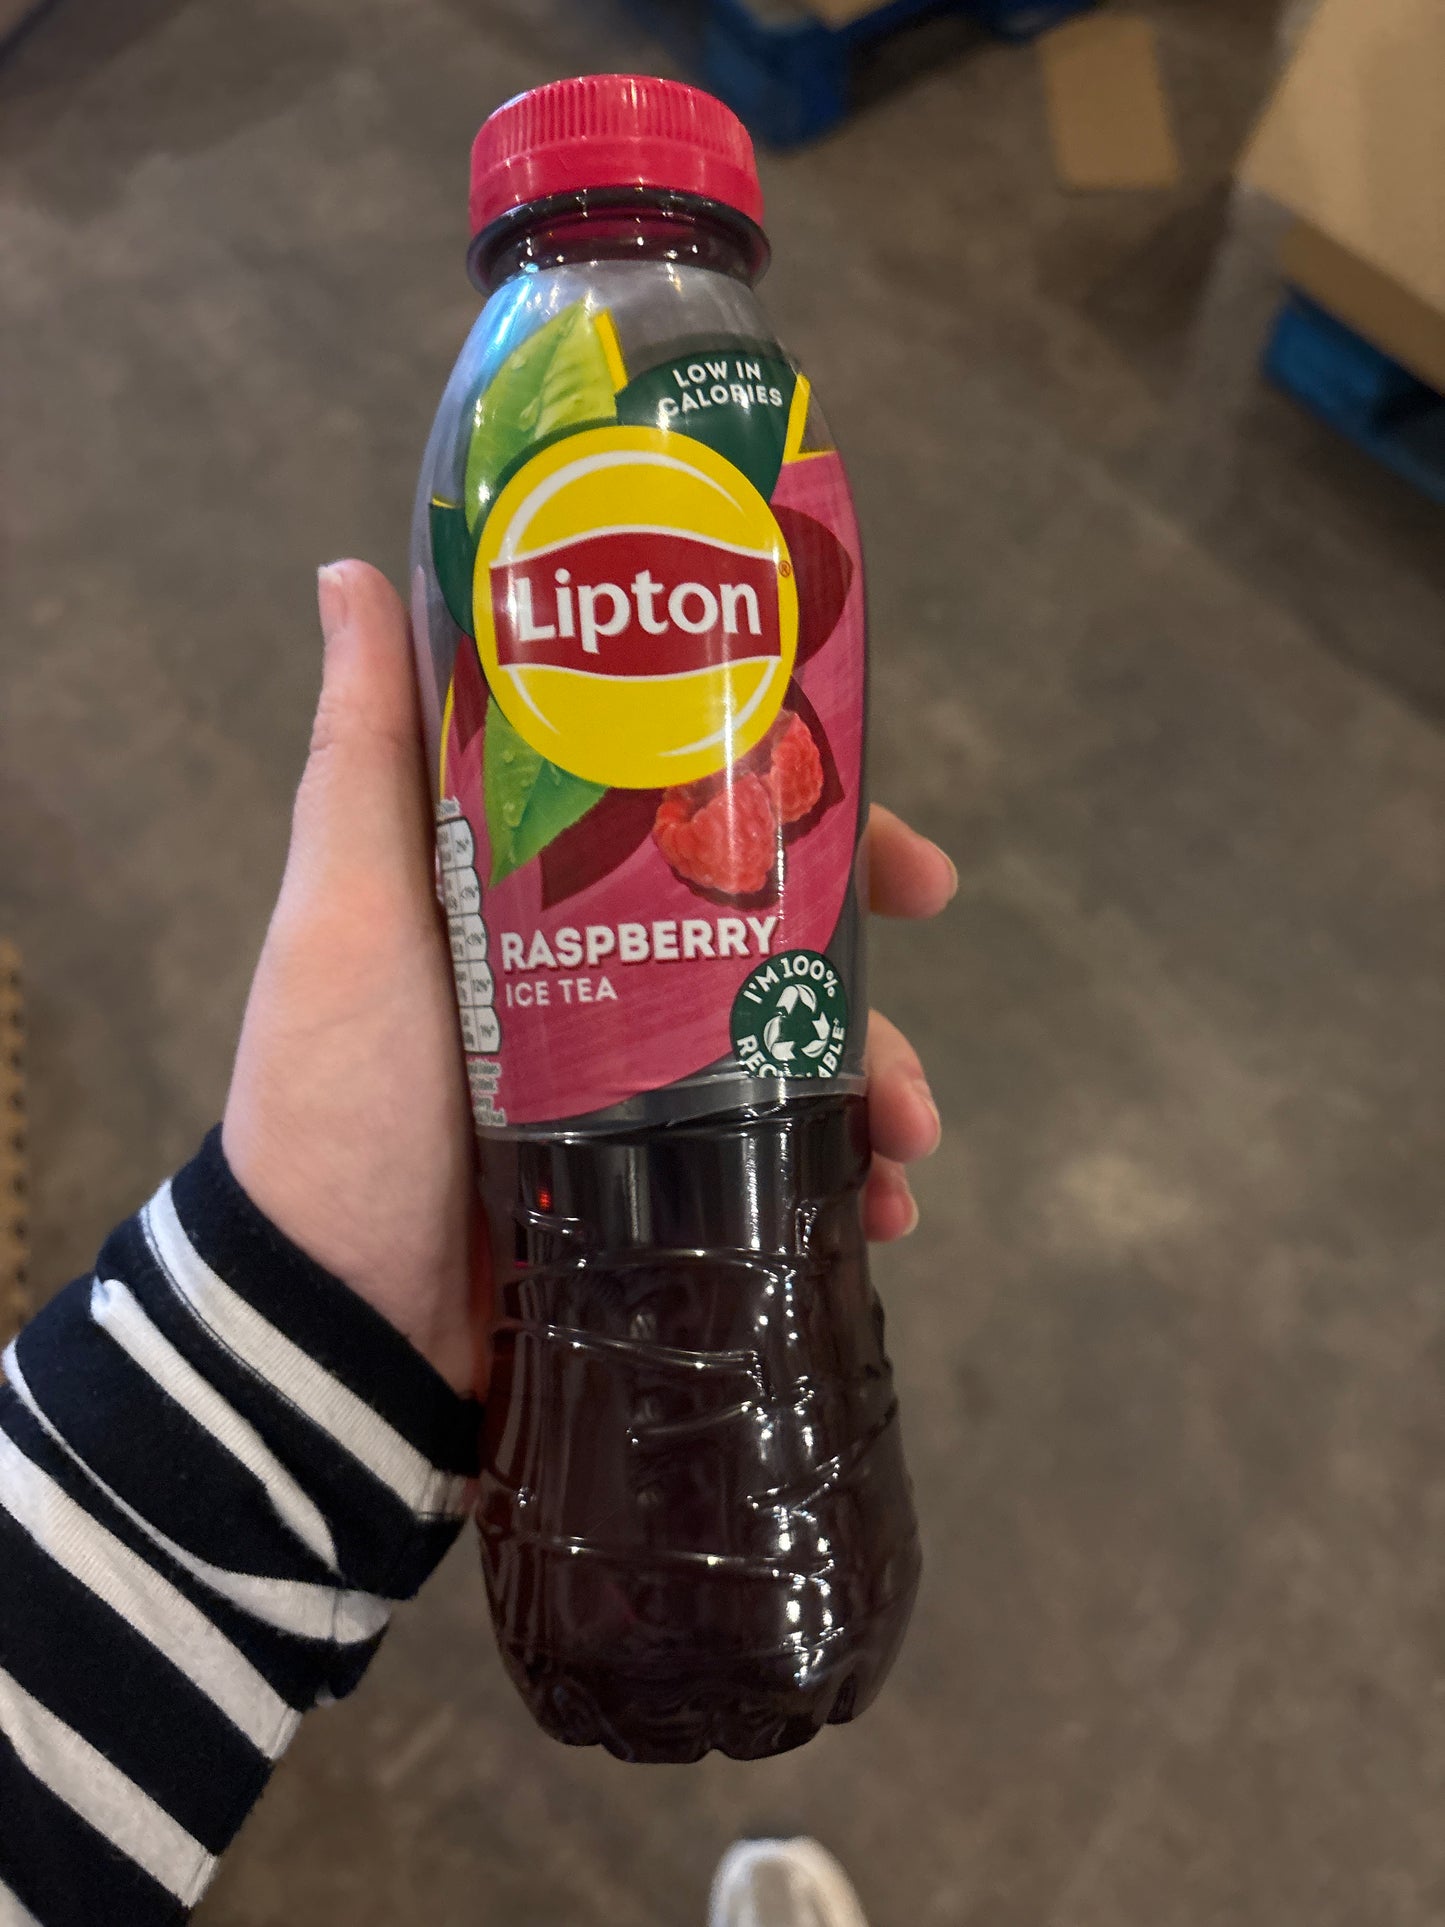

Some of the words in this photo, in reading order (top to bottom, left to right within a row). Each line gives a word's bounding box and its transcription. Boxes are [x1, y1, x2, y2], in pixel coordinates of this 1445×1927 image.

[672, 360, 728, 388] LOW
[735, 361, 762, 381] IN
[658, 384, 783, 416] CALORIES
[515, 568, 763, 654] Lipton
[500, 916, 778, 973] RASPBERRY
[505, 980, 550, 1008] ICE
[558, 976, 618, 1005] TEA
[743, 965, 780, 1004] I'M
[780, 955, 838, 998] 100%
